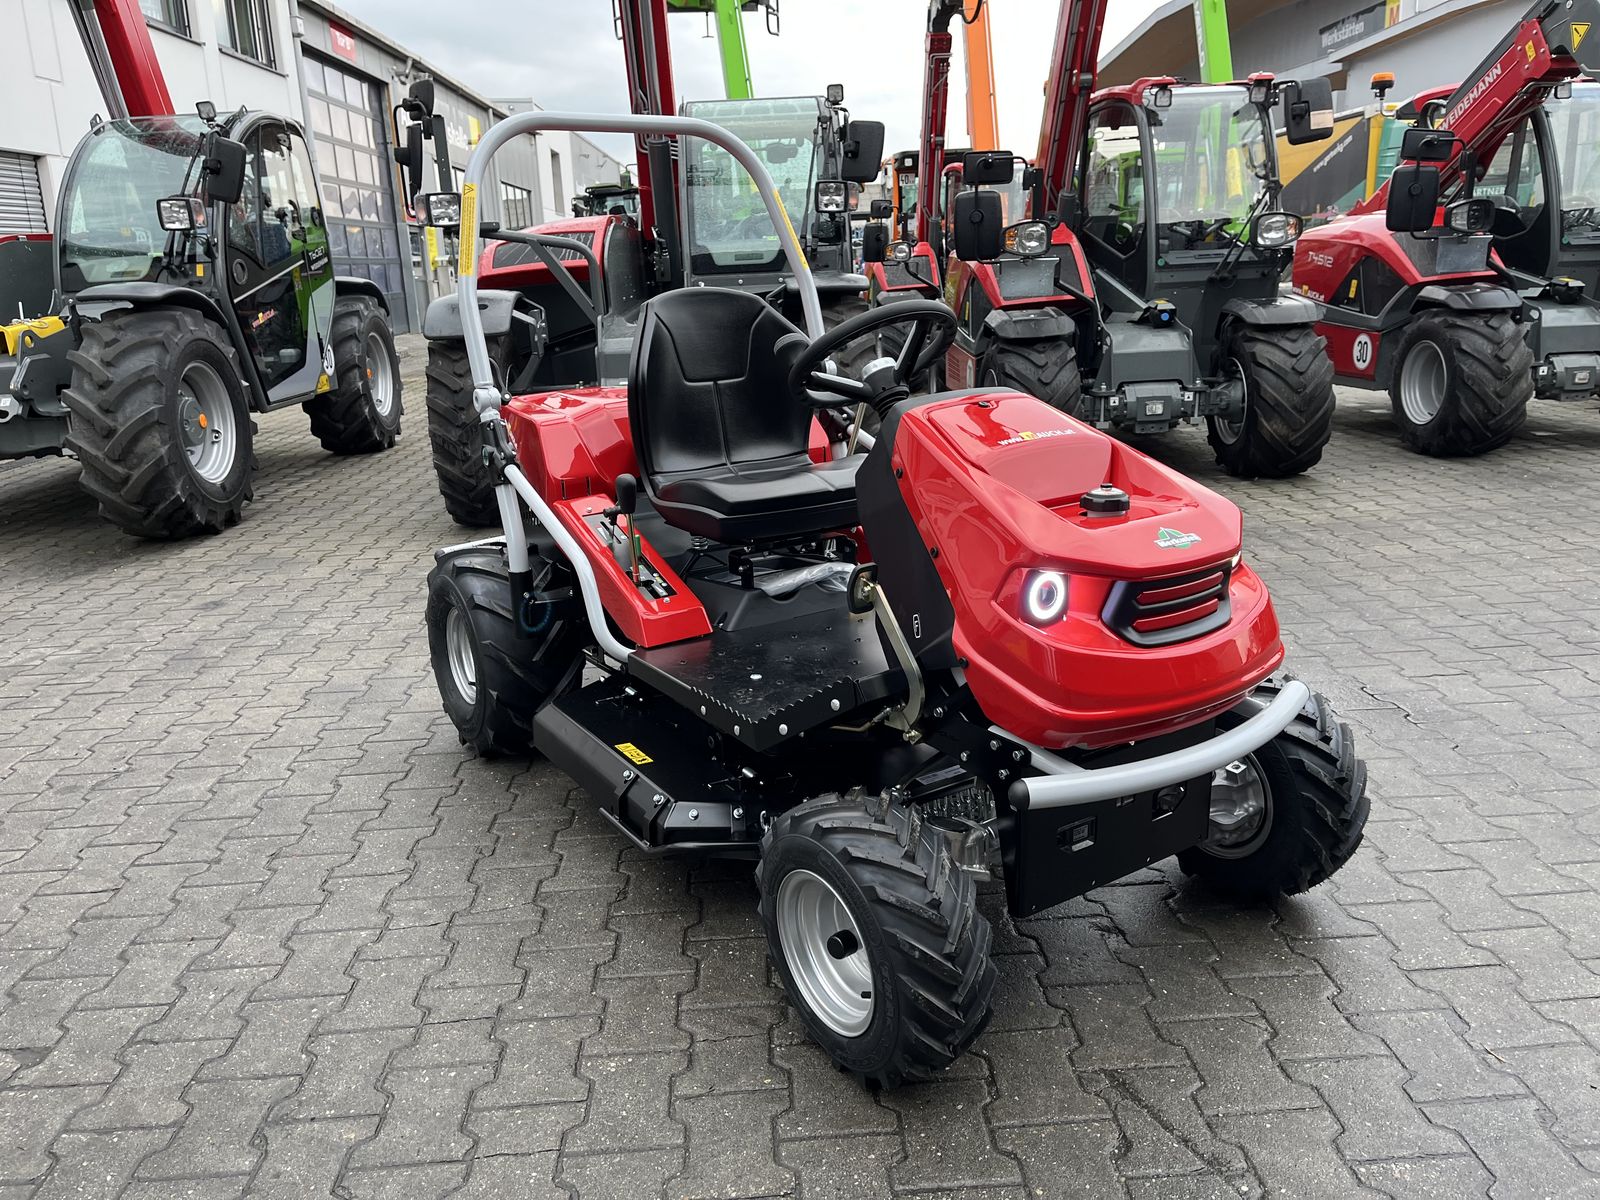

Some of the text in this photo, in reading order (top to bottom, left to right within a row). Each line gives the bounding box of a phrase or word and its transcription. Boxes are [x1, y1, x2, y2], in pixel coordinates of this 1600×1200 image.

[1322, 22, 1364, 47] Werkstätten
[1439, 63, 1503, 131] WEIDEMANN
[1473, 186, 1506, 197] ARTNER
[1308, 252, 1334, 267] T4512
[1356, 341, 1368, 363] 30
